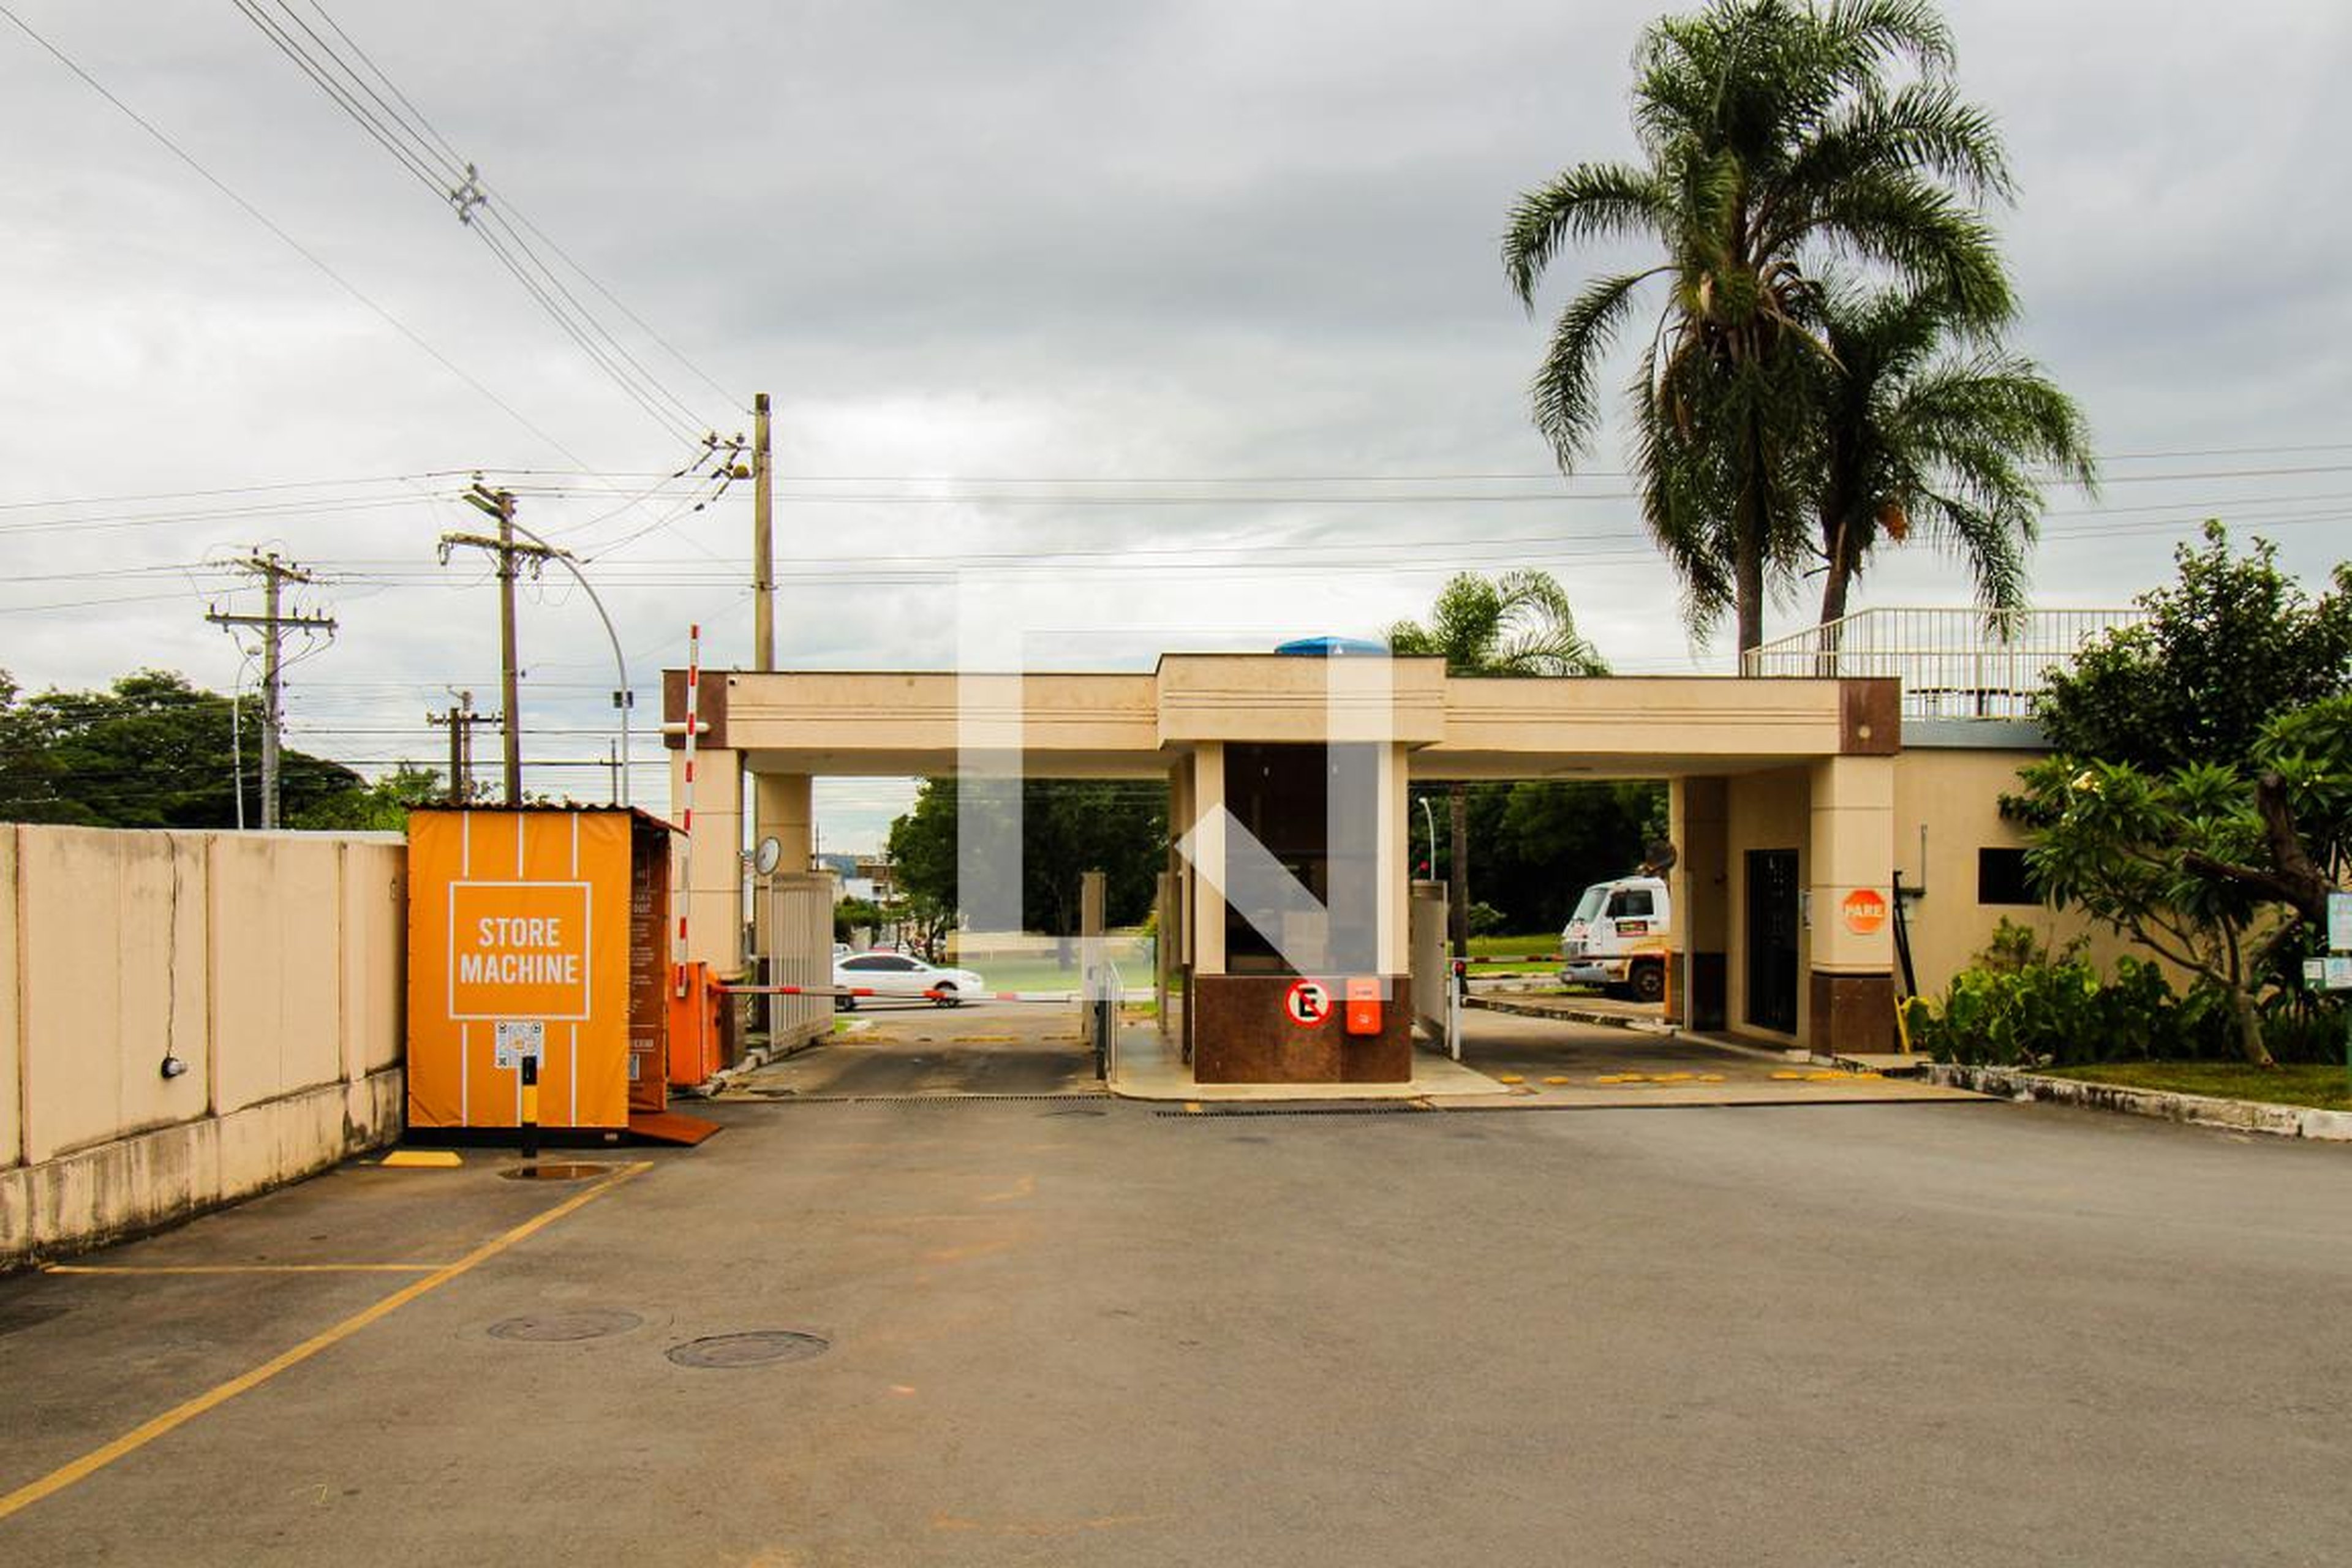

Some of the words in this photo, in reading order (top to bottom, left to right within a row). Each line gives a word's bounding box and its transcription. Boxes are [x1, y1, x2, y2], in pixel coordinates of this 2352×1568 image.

[1845, 903, 1883, 918] PARE
[478, 918, 560, 946] STORE
[461, 953, 578, 984] MACHINE
